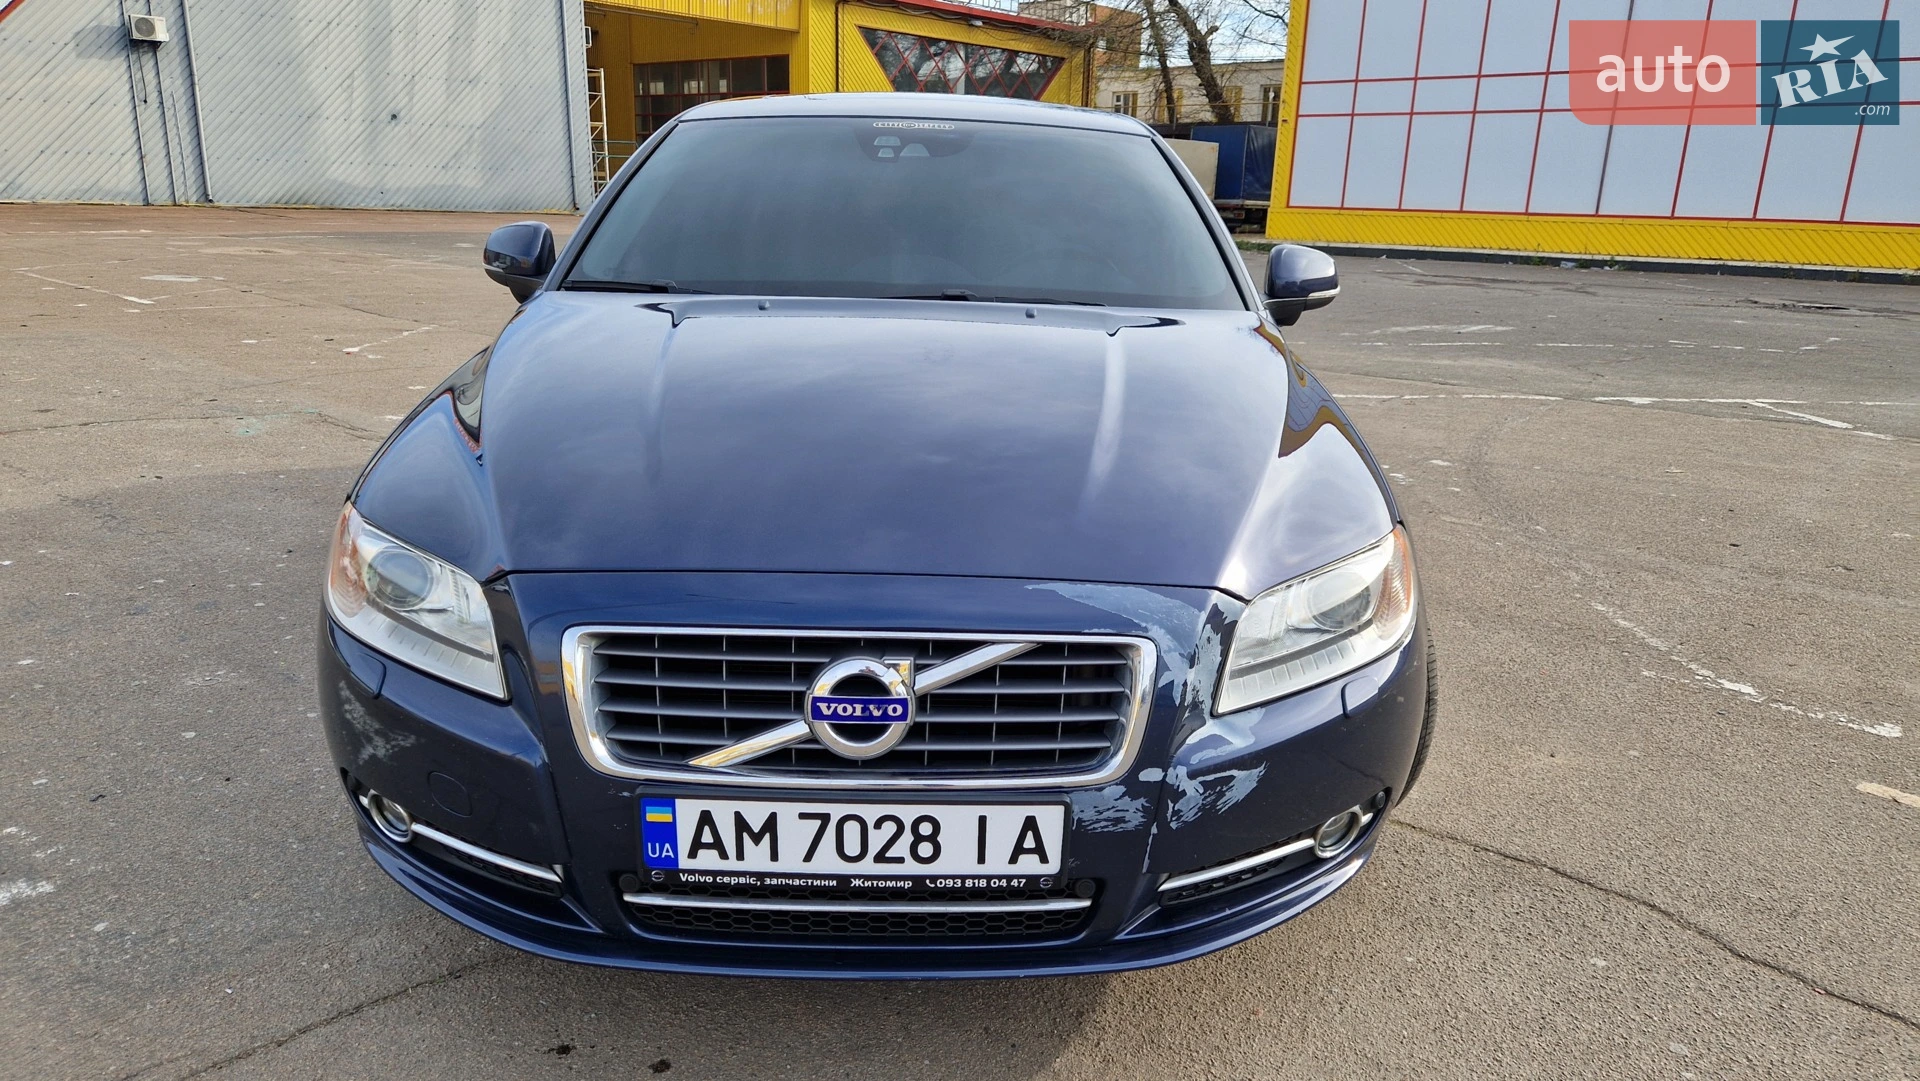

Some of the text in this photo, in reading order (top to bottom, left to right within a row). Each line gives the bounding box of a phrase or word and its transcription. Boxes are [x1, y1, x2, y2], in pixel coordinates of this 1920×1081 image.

[816, 702, 903, 717] VOLVO
[686, 808, 779, 862] AM
[797, 812, 942, 865] 7028
[647, 841, 676, 859] UA
[680, 872, 1027, 889] Volvo сервіс, запчастини Житомир 093 818 04 47
